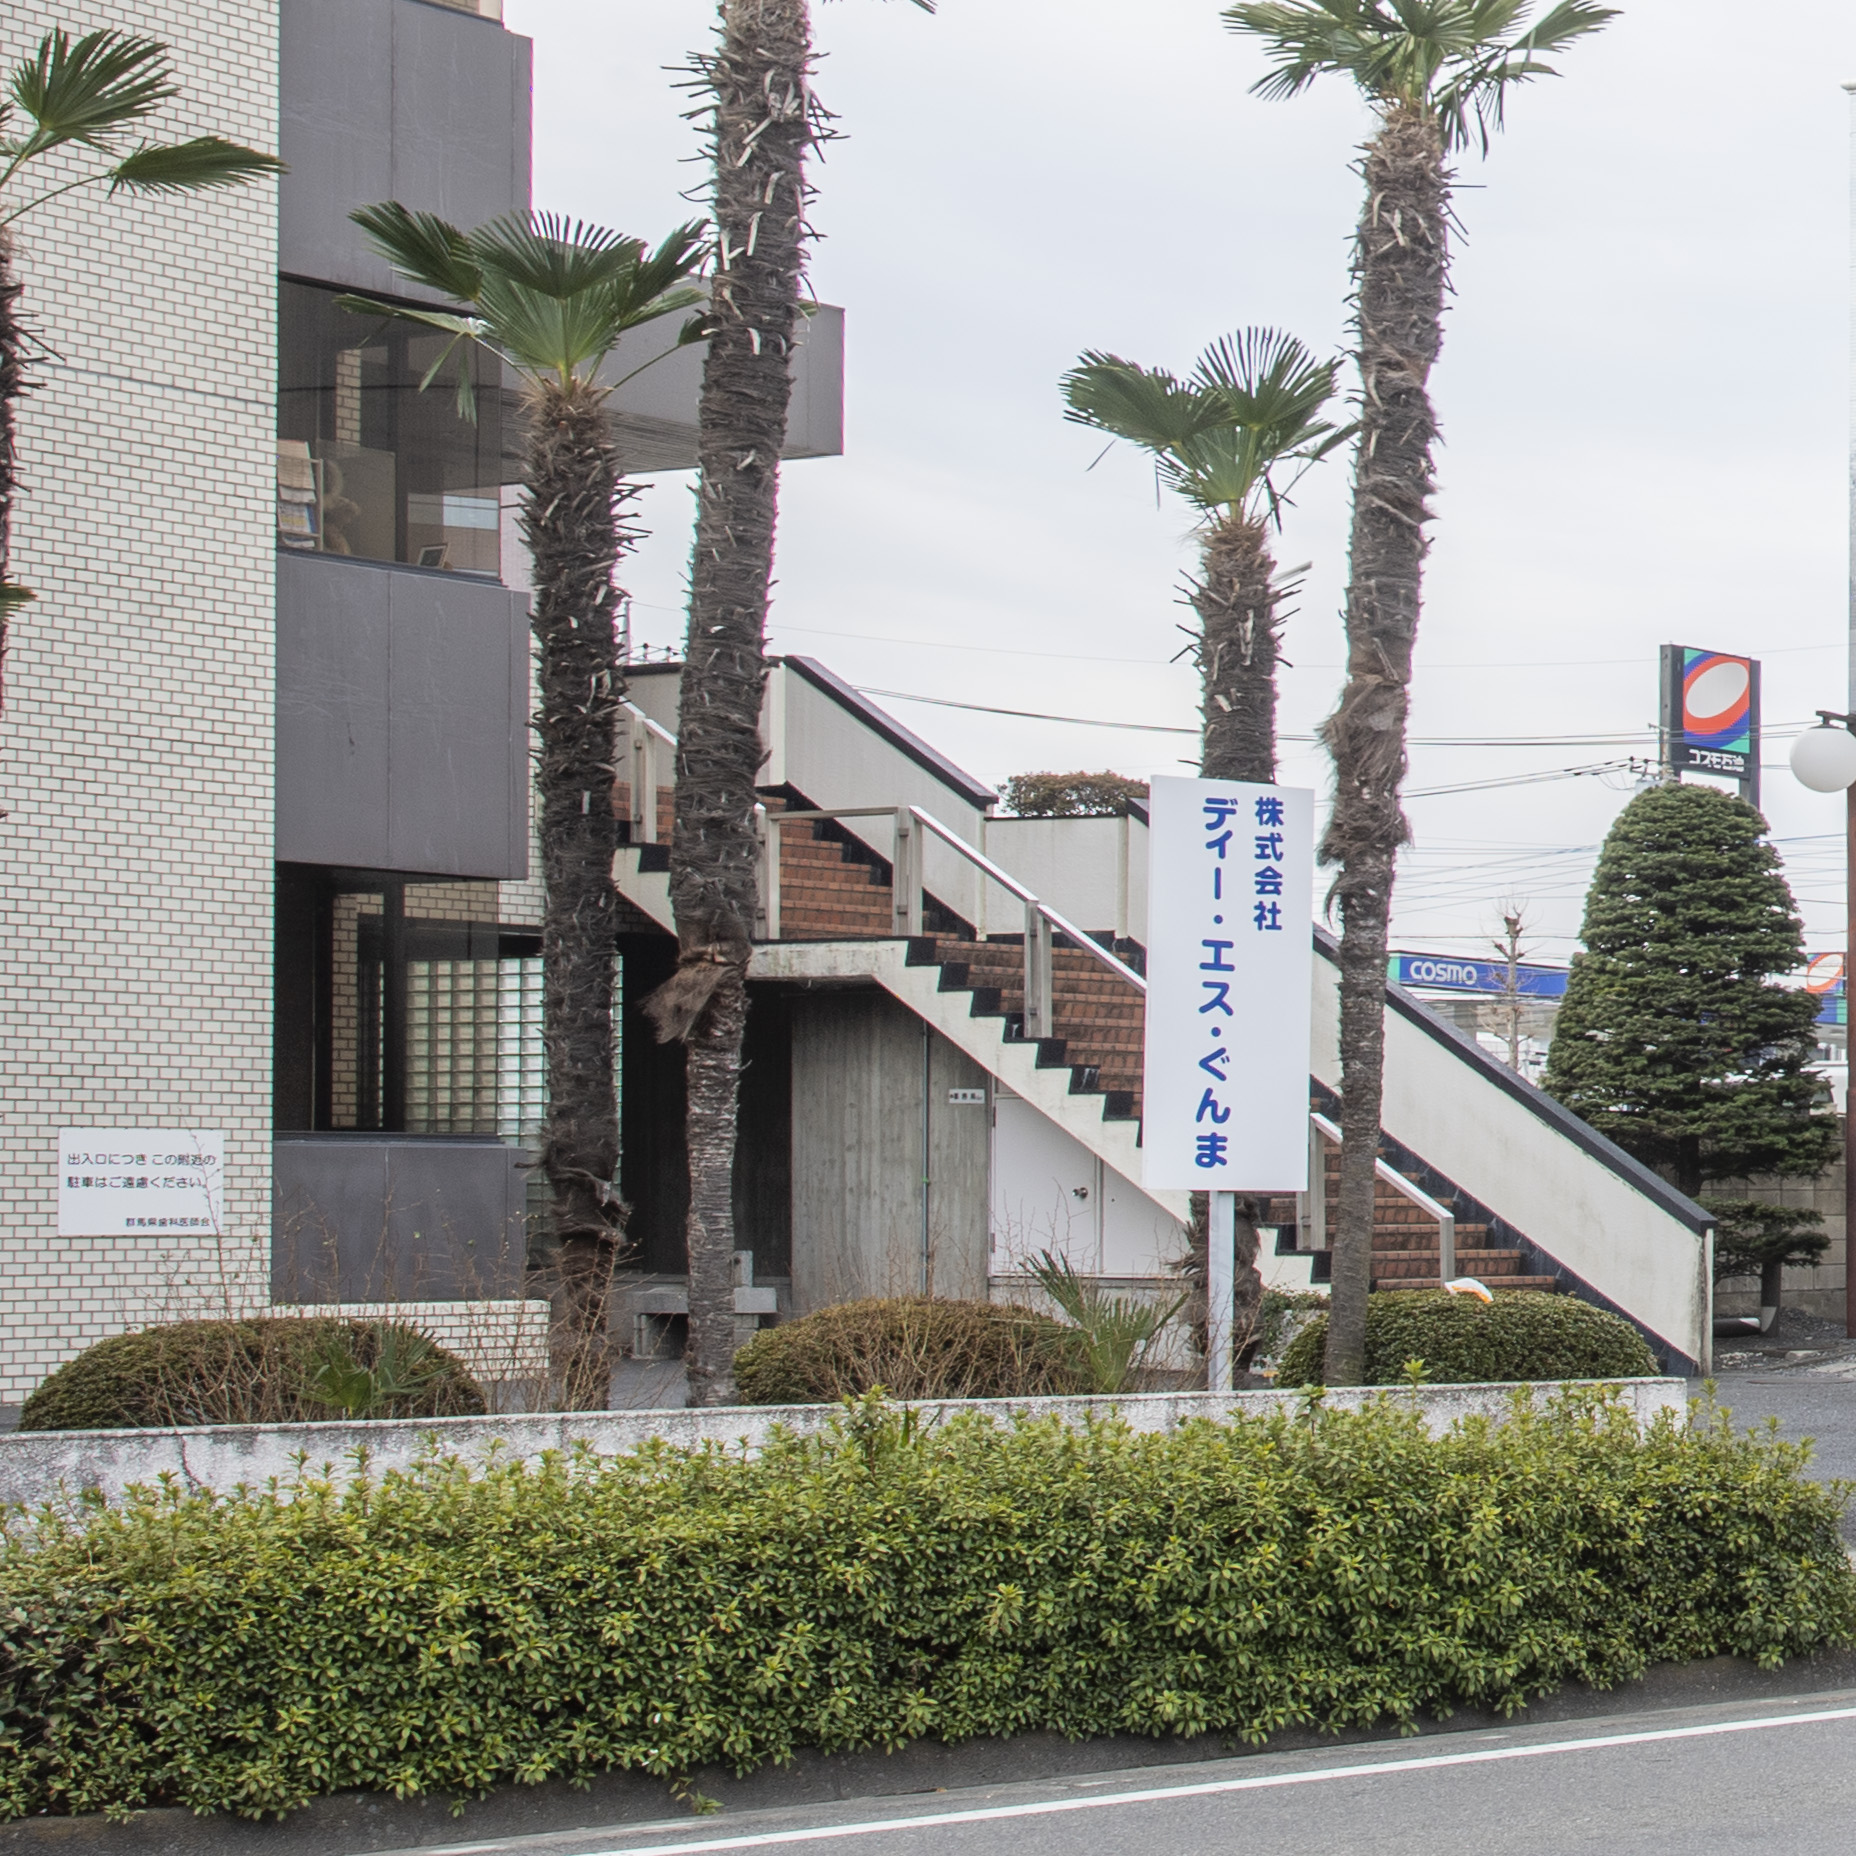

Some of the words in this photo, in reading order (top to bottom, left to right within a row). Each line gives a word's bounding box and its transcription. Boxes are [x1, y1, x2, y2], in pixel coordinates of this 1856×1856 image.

[1688, 748, 1745, 773] コスモ石油
[1253, 795, 1285, 931] 株式会社
[1194, 796, 1239, 1169] ディー・エス・ぐんま
[1410, 960, 1478, 985] COSMO
[67, 1153, 148, 1166] 出入口につき
[67, 1176, 207, 1188] 駐車はご遠慮ください。
